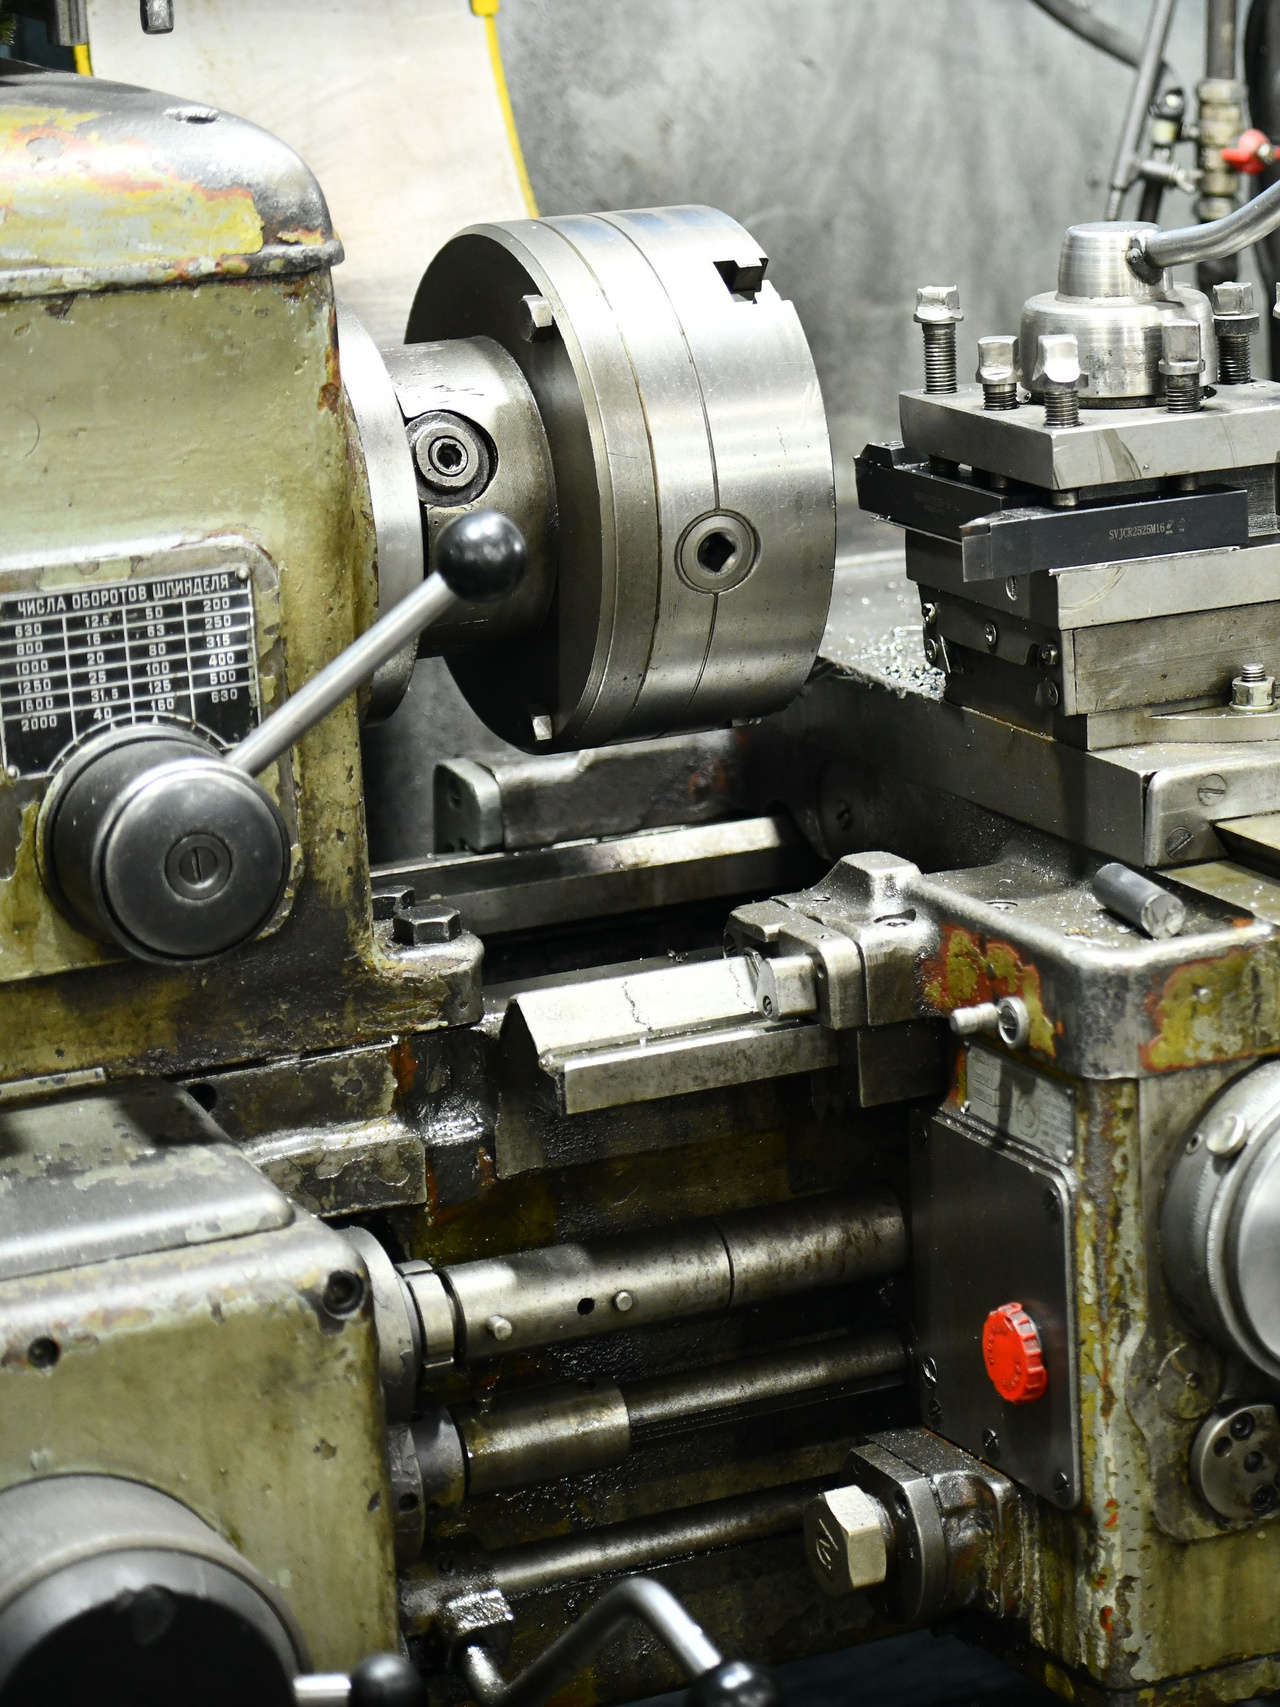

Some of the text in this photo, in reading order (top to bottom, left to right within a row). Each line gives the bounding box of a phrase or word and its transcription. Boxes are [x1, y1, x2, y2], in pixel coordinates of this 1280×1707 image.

[17, 574, 229, 617] ЧИСЛА ОБОРОТОВ ШПИНДЕЛЯ
[203, 598, 230, 612] 200
[145, 606, 164, 620] 50
[204, 615, 231, 629] 250
[15, 623, 42, 638] 630
[147, 624, 165, 638] 63
[86, 633, 101, 646] 16
[206, 634, 231, 648] 315
[16, 641, 44, 656] 800
[148, 643, 166, 657] 80
[86, 651, 104, 666] 20
[208, 652, 235, 667] 400
[15, 659, 49, 676] 1000
[146, 661, 170, 676] 100
[88, 671, 107, 685] 25
[210, 670, 236, 685] 500
[17, 678, 51, 695] 1250
[148, 679, 172, 694] 125
[211, 688, 238, 703] 630
[20, 696, 54, 713] 1600
[150, 697, 175, 712] 160
[93, 707, 112, 721] 40
[21, 715, 57, 732] 2000
